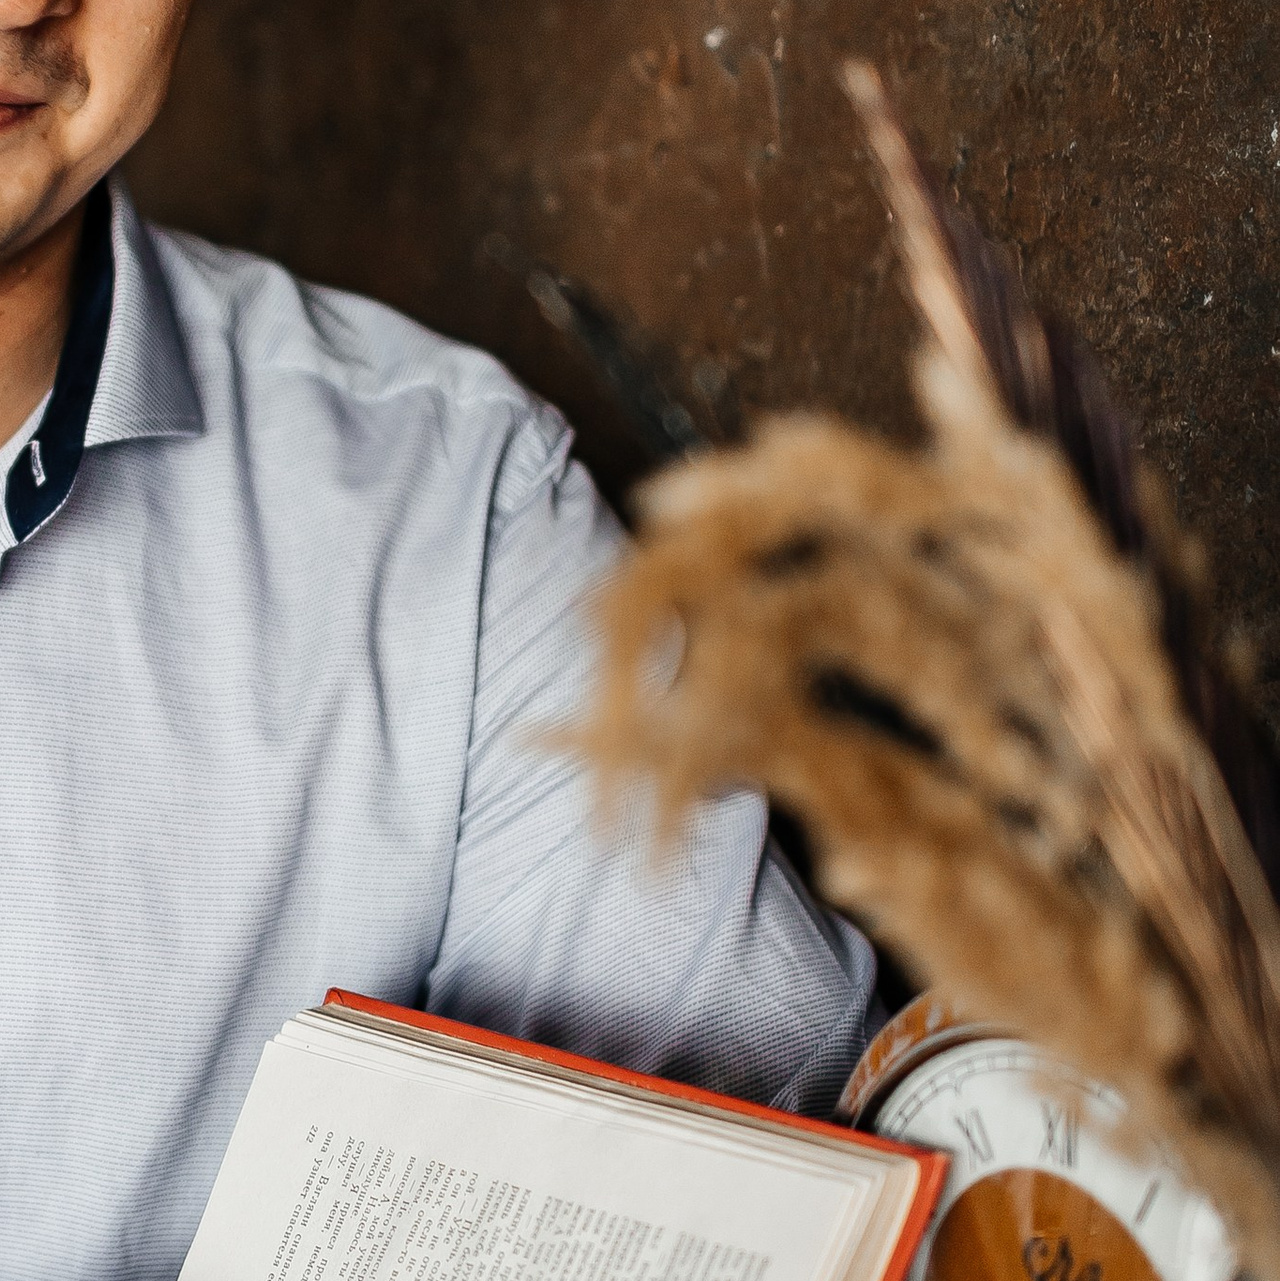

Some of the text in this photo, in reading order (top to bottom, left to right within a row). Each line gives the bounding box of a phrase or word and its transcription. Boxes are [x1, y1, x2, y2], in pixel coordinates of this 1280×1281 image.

[304, 1123, 319, 1144] 212
[319, 1130, 334, 1153] она
[336, 1134, 356, 1169] делу.
[298, 1156, 323, 1200] узнает
[340, 1139, 365, 1188] слушал
[348, 1144, 385, 1219] ликодушие.
[372, 1147, 396, 1190] дойди.
[430, 1161, 446, 1185] рое
[462, 1171, 479, 1197] гой.
[299, 1174, 330, 1227] Взгляни
[381, 1154, 417, 1227] вошедшего
[406, 1159, 436, 1215] оргием...
[430, 1166, 457, 1210] монах,
[319, 1198, 341, 1233] меня,
[325, 1200, 351, 1251] пришел
[345, 1194, 379, 1256] Надеюсь,
[364, 1213, 381, 1240] мой
[435, 1203, 453, 1230] еще
[441, 1215, 463, 1245] Уже
[465, 1178, 500, 1241] тановись,
[271, 1202, 303, 1268] спасителя
[367, 1223, 398, 1280] клянись!
[396, 1208, 425, 1264] очень-то
[415, 1217, 433, 1248] если
[444, 1218, 474, 1263] Прочь,
